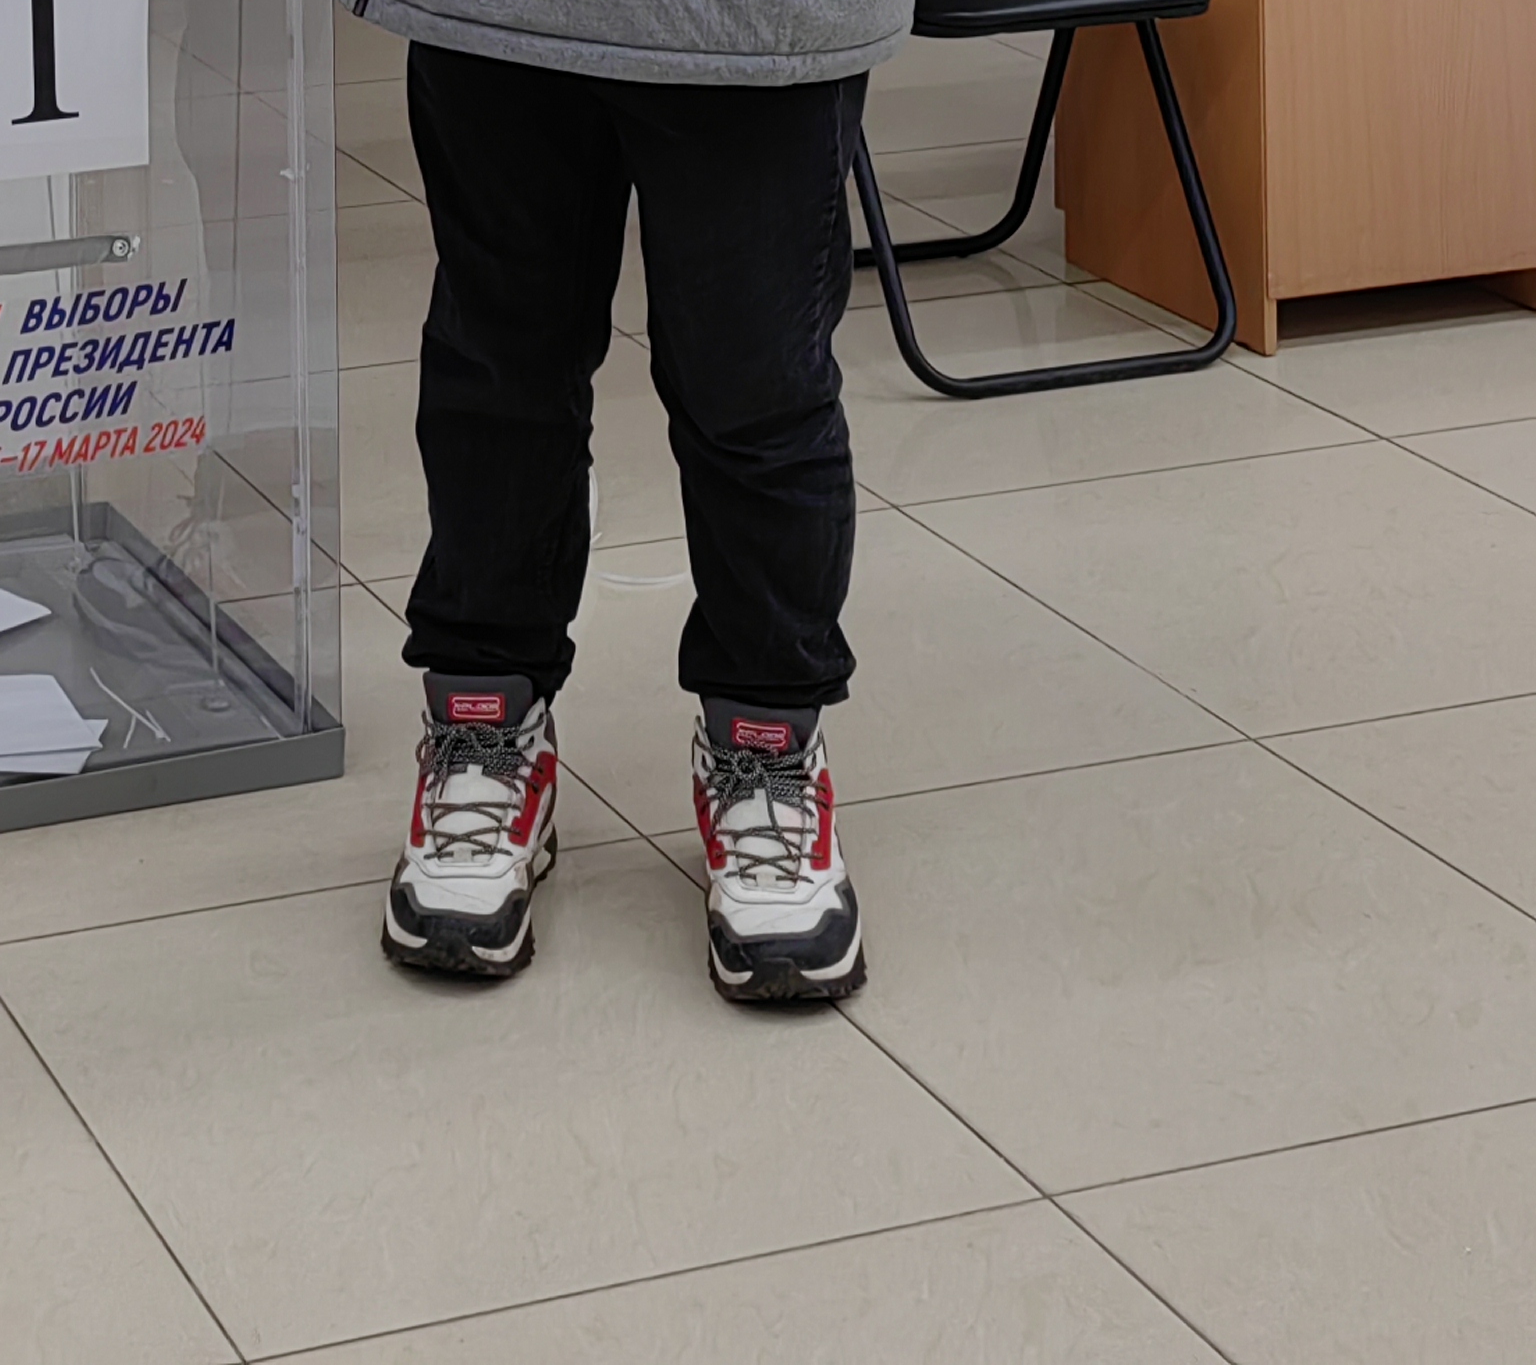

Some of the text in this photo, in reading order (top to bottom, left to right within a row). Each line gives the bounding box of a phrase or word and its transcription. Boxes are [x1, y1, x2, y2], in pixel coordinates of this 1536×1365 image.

[19, 277, 188, 335] ВЫБОРЫ
[1, 317, 236, 386] ПРЕЗИДЕНТА
[48, 426, 139, 470] МАРТА
[143, 415, 206, 455] 2024
